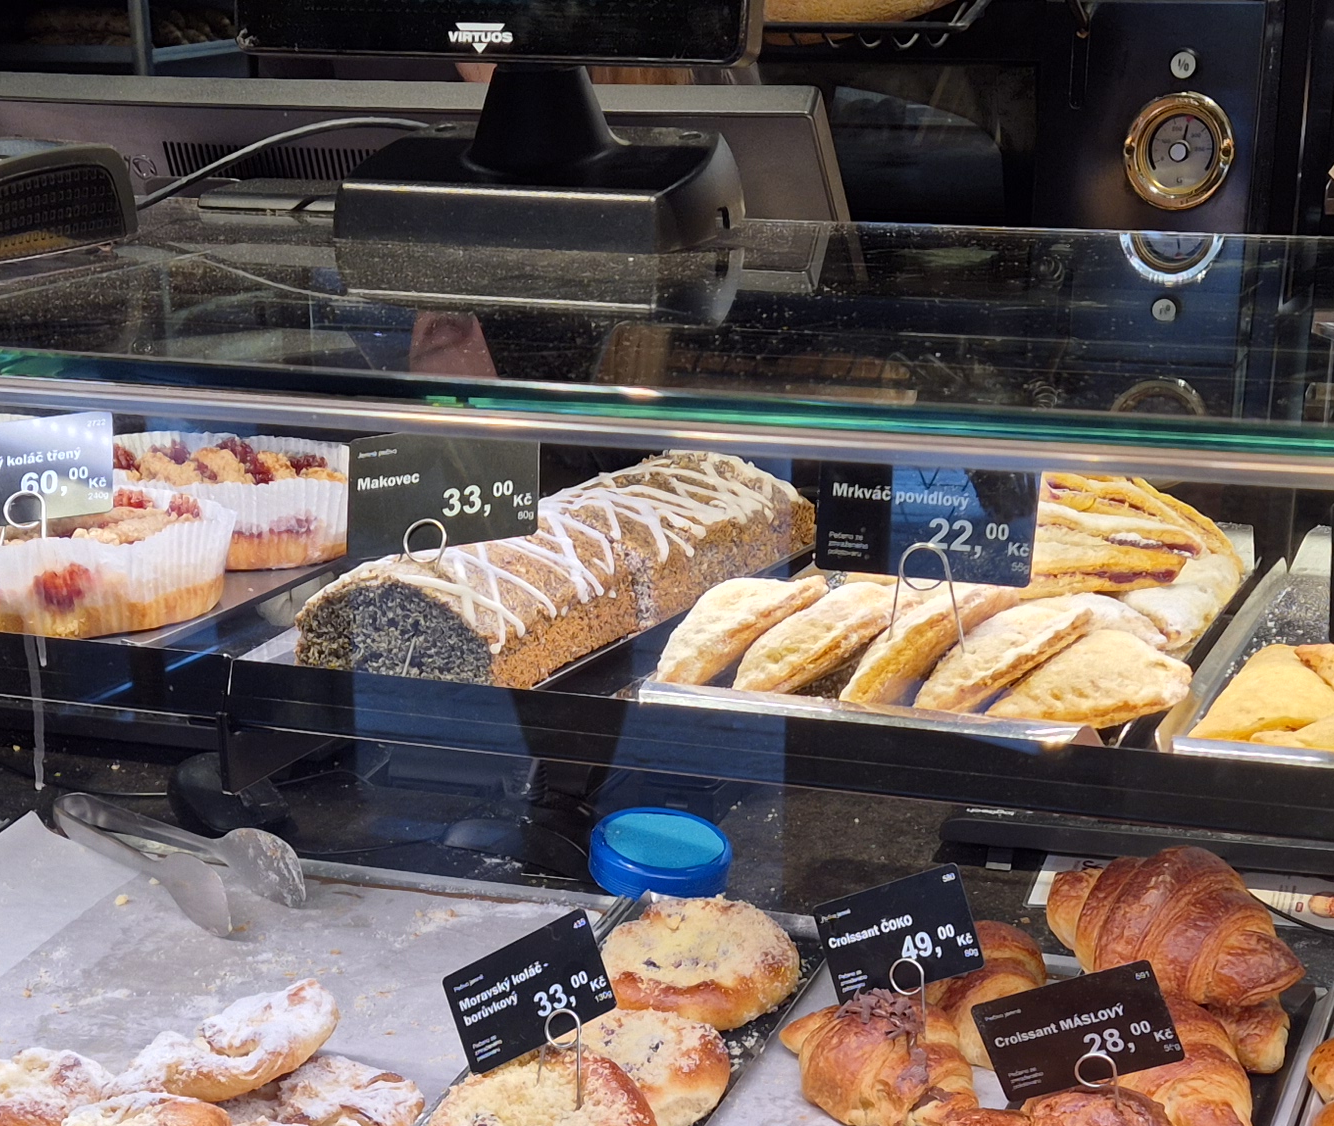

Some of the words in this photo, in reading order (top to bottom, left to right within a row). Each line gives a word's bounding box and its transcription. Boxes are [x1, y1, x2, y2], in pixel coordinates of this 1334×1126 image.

[448, 31, 513, 43] VIRTUOS
[6, 452, 43, 467] koláč
[47, 447, 81, 461] třený
[20, 466, 88, 496] 60,00
[88, 477, 106, 488] Kč
[88, 492, 109, 500] 240g
[357, 473, 420, 491] Makovec
[442, 480, 513, 517] 33,00
[513, 493, 533, 507] Kč
[832, 482, 892, 501] Mrkváč
[895, 490, 970, 510] povidlový
[928, 518, 1009, 559] 22,00
[1008, 542, 1030, 557] Kč
[828, 925, 880, 949] Croissant
[880, 914, 913, 933] ČOKO
[901, 924, 955, 960] 49,00
[956, 932, 973, 947] Kč
[458, 978, 512, 1012] Moravský
[511, 961, 543, 986] koláč
[533, 971, 588, 1017] 33,00
[590, 975, 607, 992] Kč
[463, 991, 518, 1027] borůvkový
[994, 1024, 1059, 1048] Croissant
[1059, 1002, 1125, 1031] MÁSLOVÝ
[1083, 1020, 1151, 1055] 28,00
[1153, 1028, 1175, 1042] Kč
